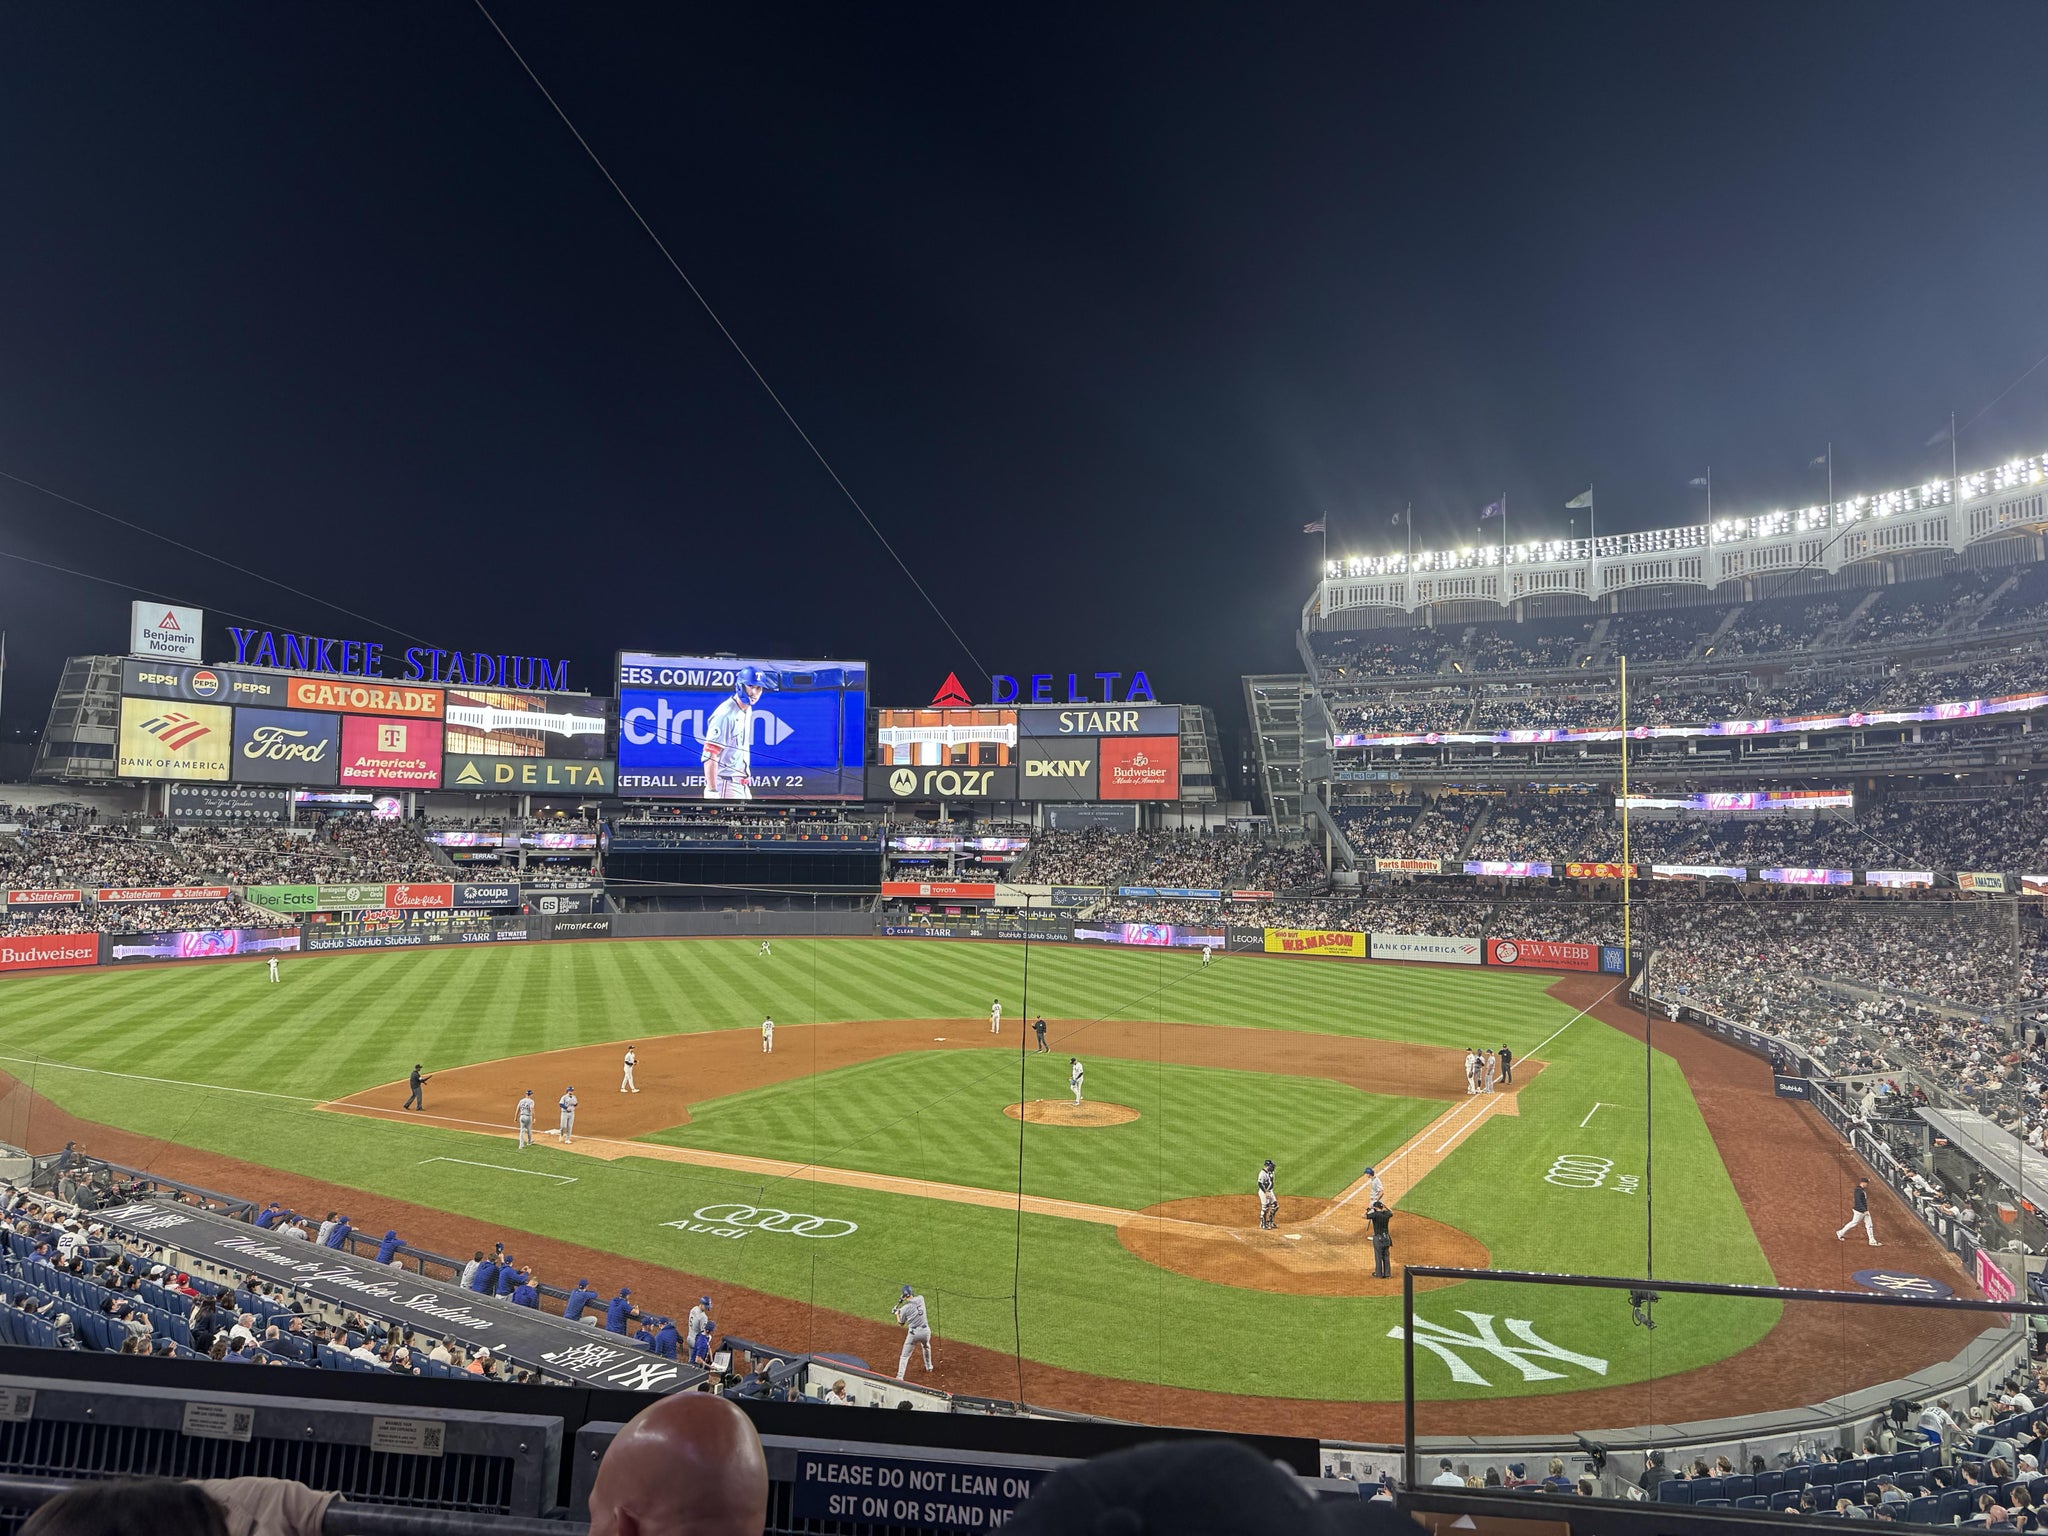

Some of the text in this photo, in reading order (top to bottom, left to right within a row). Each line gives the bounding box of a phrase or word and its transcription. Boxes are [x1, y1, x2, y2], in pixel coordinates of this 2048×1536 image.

[144, 628, 194, 644] Benjamin
[150, 640, 186, 654] Moore
[226, 627, 571, 692] YANKEE STADIUM
[138, 672, 178, 686] PEPSI
[194, 678, 218, 688] PEPSI
[621, 668, 741, 688] EES.COM/20
[233, 682, 271, 695] PEPSI
[991, 670, 1156, 704] DELTA
[298, 684, 436, 712] GATORADE
[1058, 711, 1139, 733] STARR
[244, 726, 329, 763] Ford
[121, 757, 226, 771] BANK OF AMERICA
[355, 756, 427, 769] America's
[1025, 760, 1091, 776] DKNY
[343, 766, 438, 780] Best Network
[495, 763, 605, 787] DELTA
[1113, 767, 1166, 777] Budweiser
[682, 776, 707, 788] JER
[750, 776, 780, 787] MAY
[786, 776, 804, 787] 22
[924, 770, 994, 796] razr
[1112, 776, 1132, 784] Made
[1138, 776, 1165, 784] America
[1378, 861, 1399, 869] Parts
[1400, 860, 1438, 870] Authority
[250, 894, 314, 906] Uber Eats
[478, 888, 508, 898] coupa
[542, 900, 556, 910] GS
[462, 933, 490, 942] STARR
[925, 928, 951, 936] STARR
[310, 936, 421, 950] StubHub StubHub StubHub
[1232, 935, 1264, 944] LEGORA
[1414, 945, 1457, 954] AMERICA
[1520, 944, 1590, 960] F.W. WEBB
[1607, 962, 1621, 970] LIFE
[1780, 1083, 1803, 1093] StubHub
[1610, 1174, 1640, 1194] Audi
[658, 1218, 752, 1240] Audi
[60, 1236, 74, 1247] 22
[214, 1236, 494, 1330] Welcome to Yankee Stadium
[561, 1346, 615, 1368] YORK
[576, 1342, 625, 1360] NEW
[546, 1355, 587, 1372] LIFE
[806, 1462, 873, 1486] PLEASE
[878, 1468, 904, 1488] DO
[909, 1470, 946, 1492] NOT
[952, 1474, 998, 1496] LEAN
[828, 1494, 1014, 1528] SIT ON OR STAND NE
